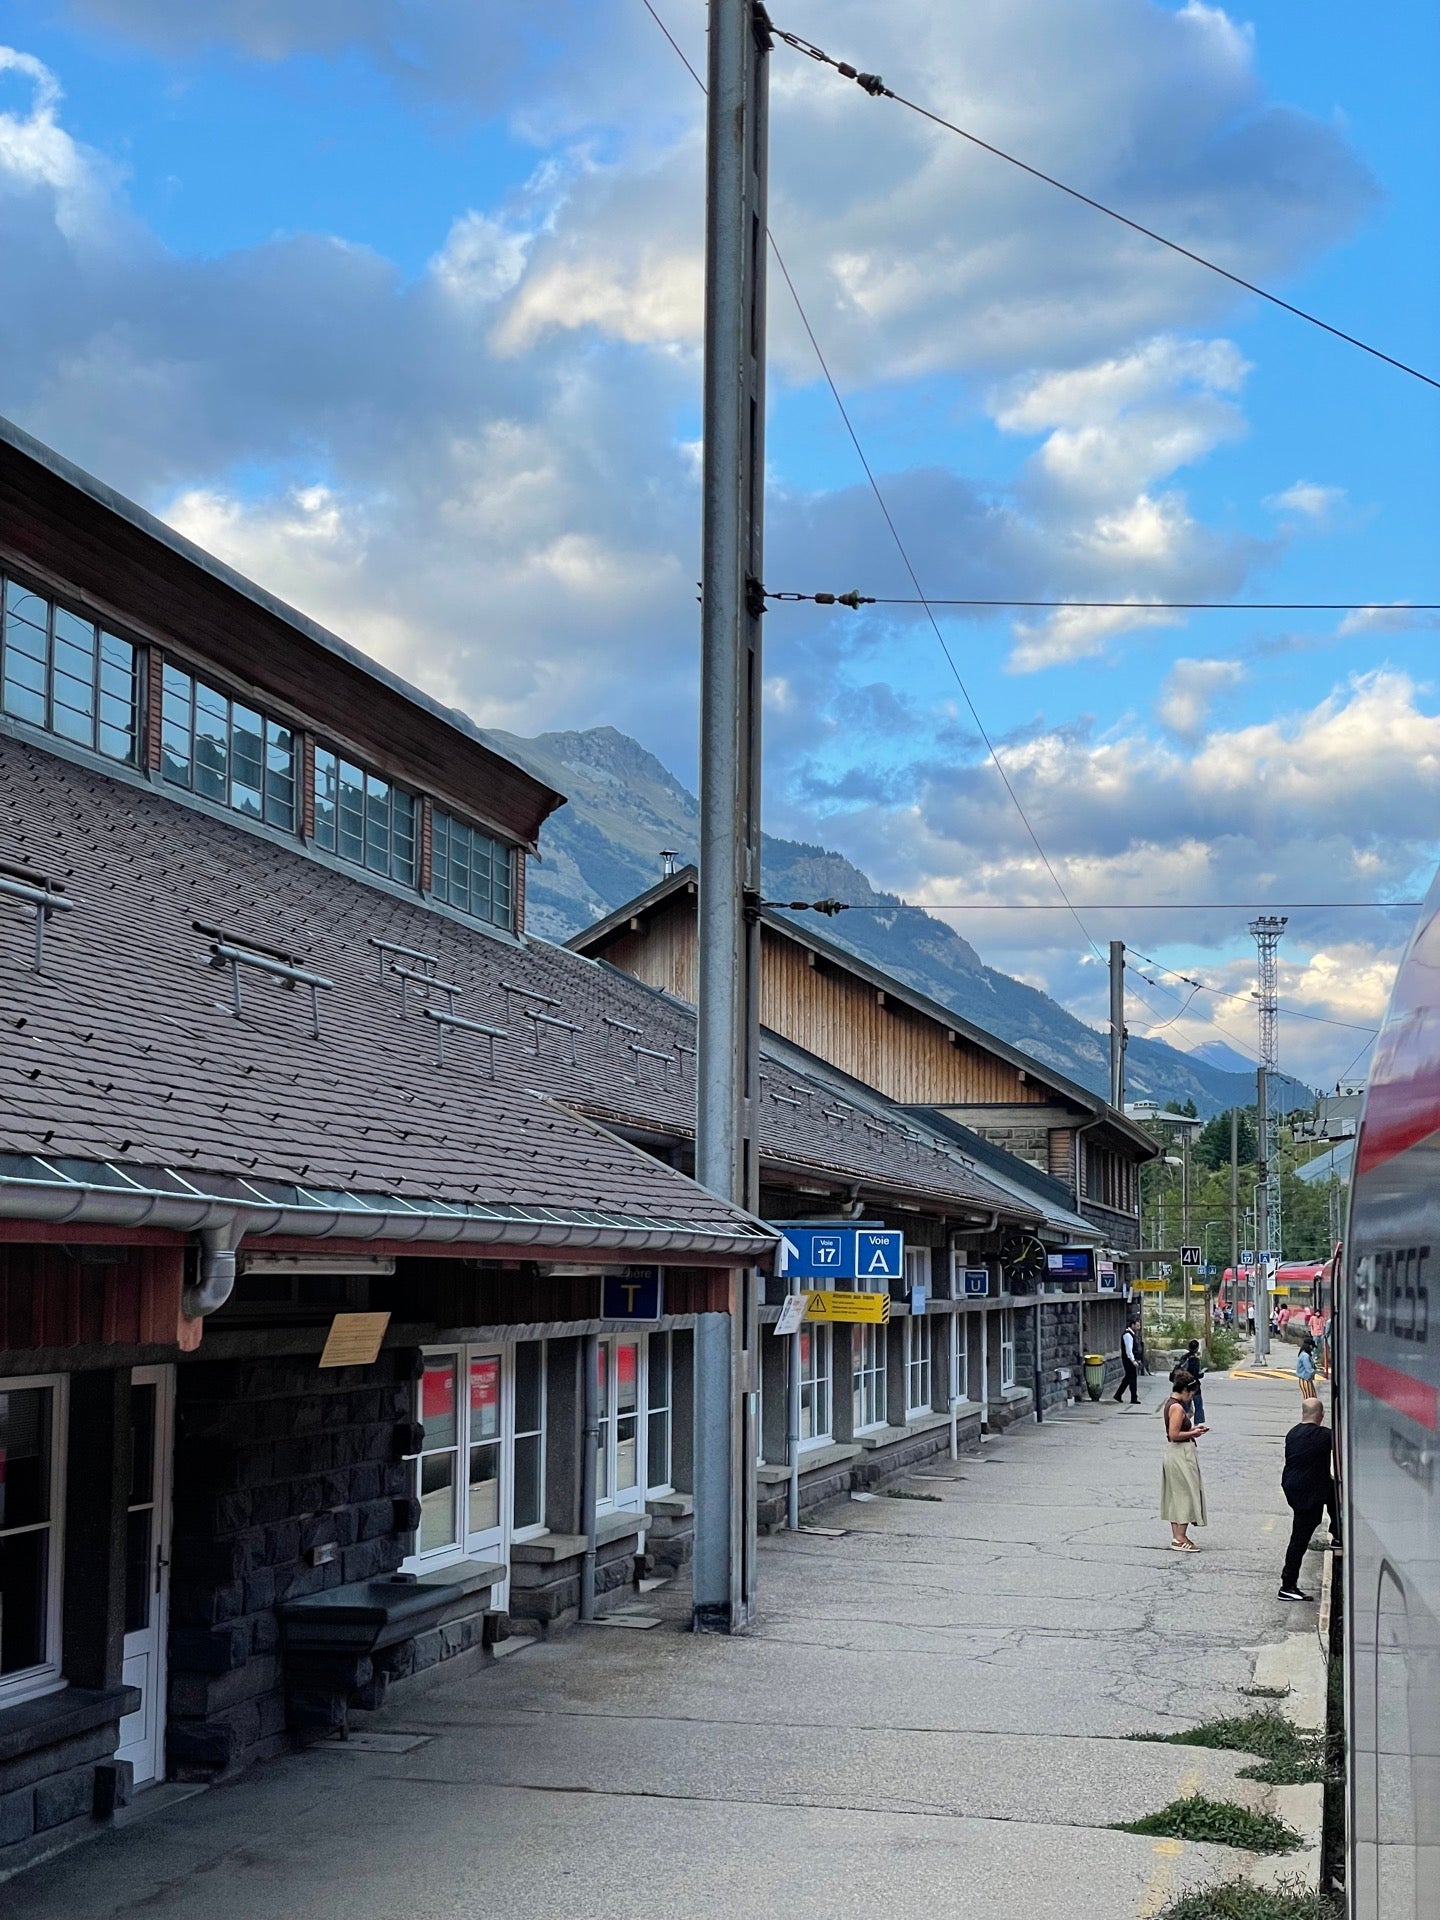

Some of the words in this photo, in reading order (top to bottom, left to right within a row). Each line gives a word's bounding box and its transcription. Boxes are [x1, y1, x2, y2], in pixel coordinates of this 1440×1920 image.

[820, 1239, 834, 1247] Voie
[868, 1235, 890, 1246] Voie
[817, 1248, 836, 1263] 17
[867, 1249, 890, 1273] A
[1183, 1249, 1199, 1263] 4V
[971, 1279, 981, 1292] U
[1104, 1279, 1112, 1287] V
[620, 1284, 642, 1313] T
